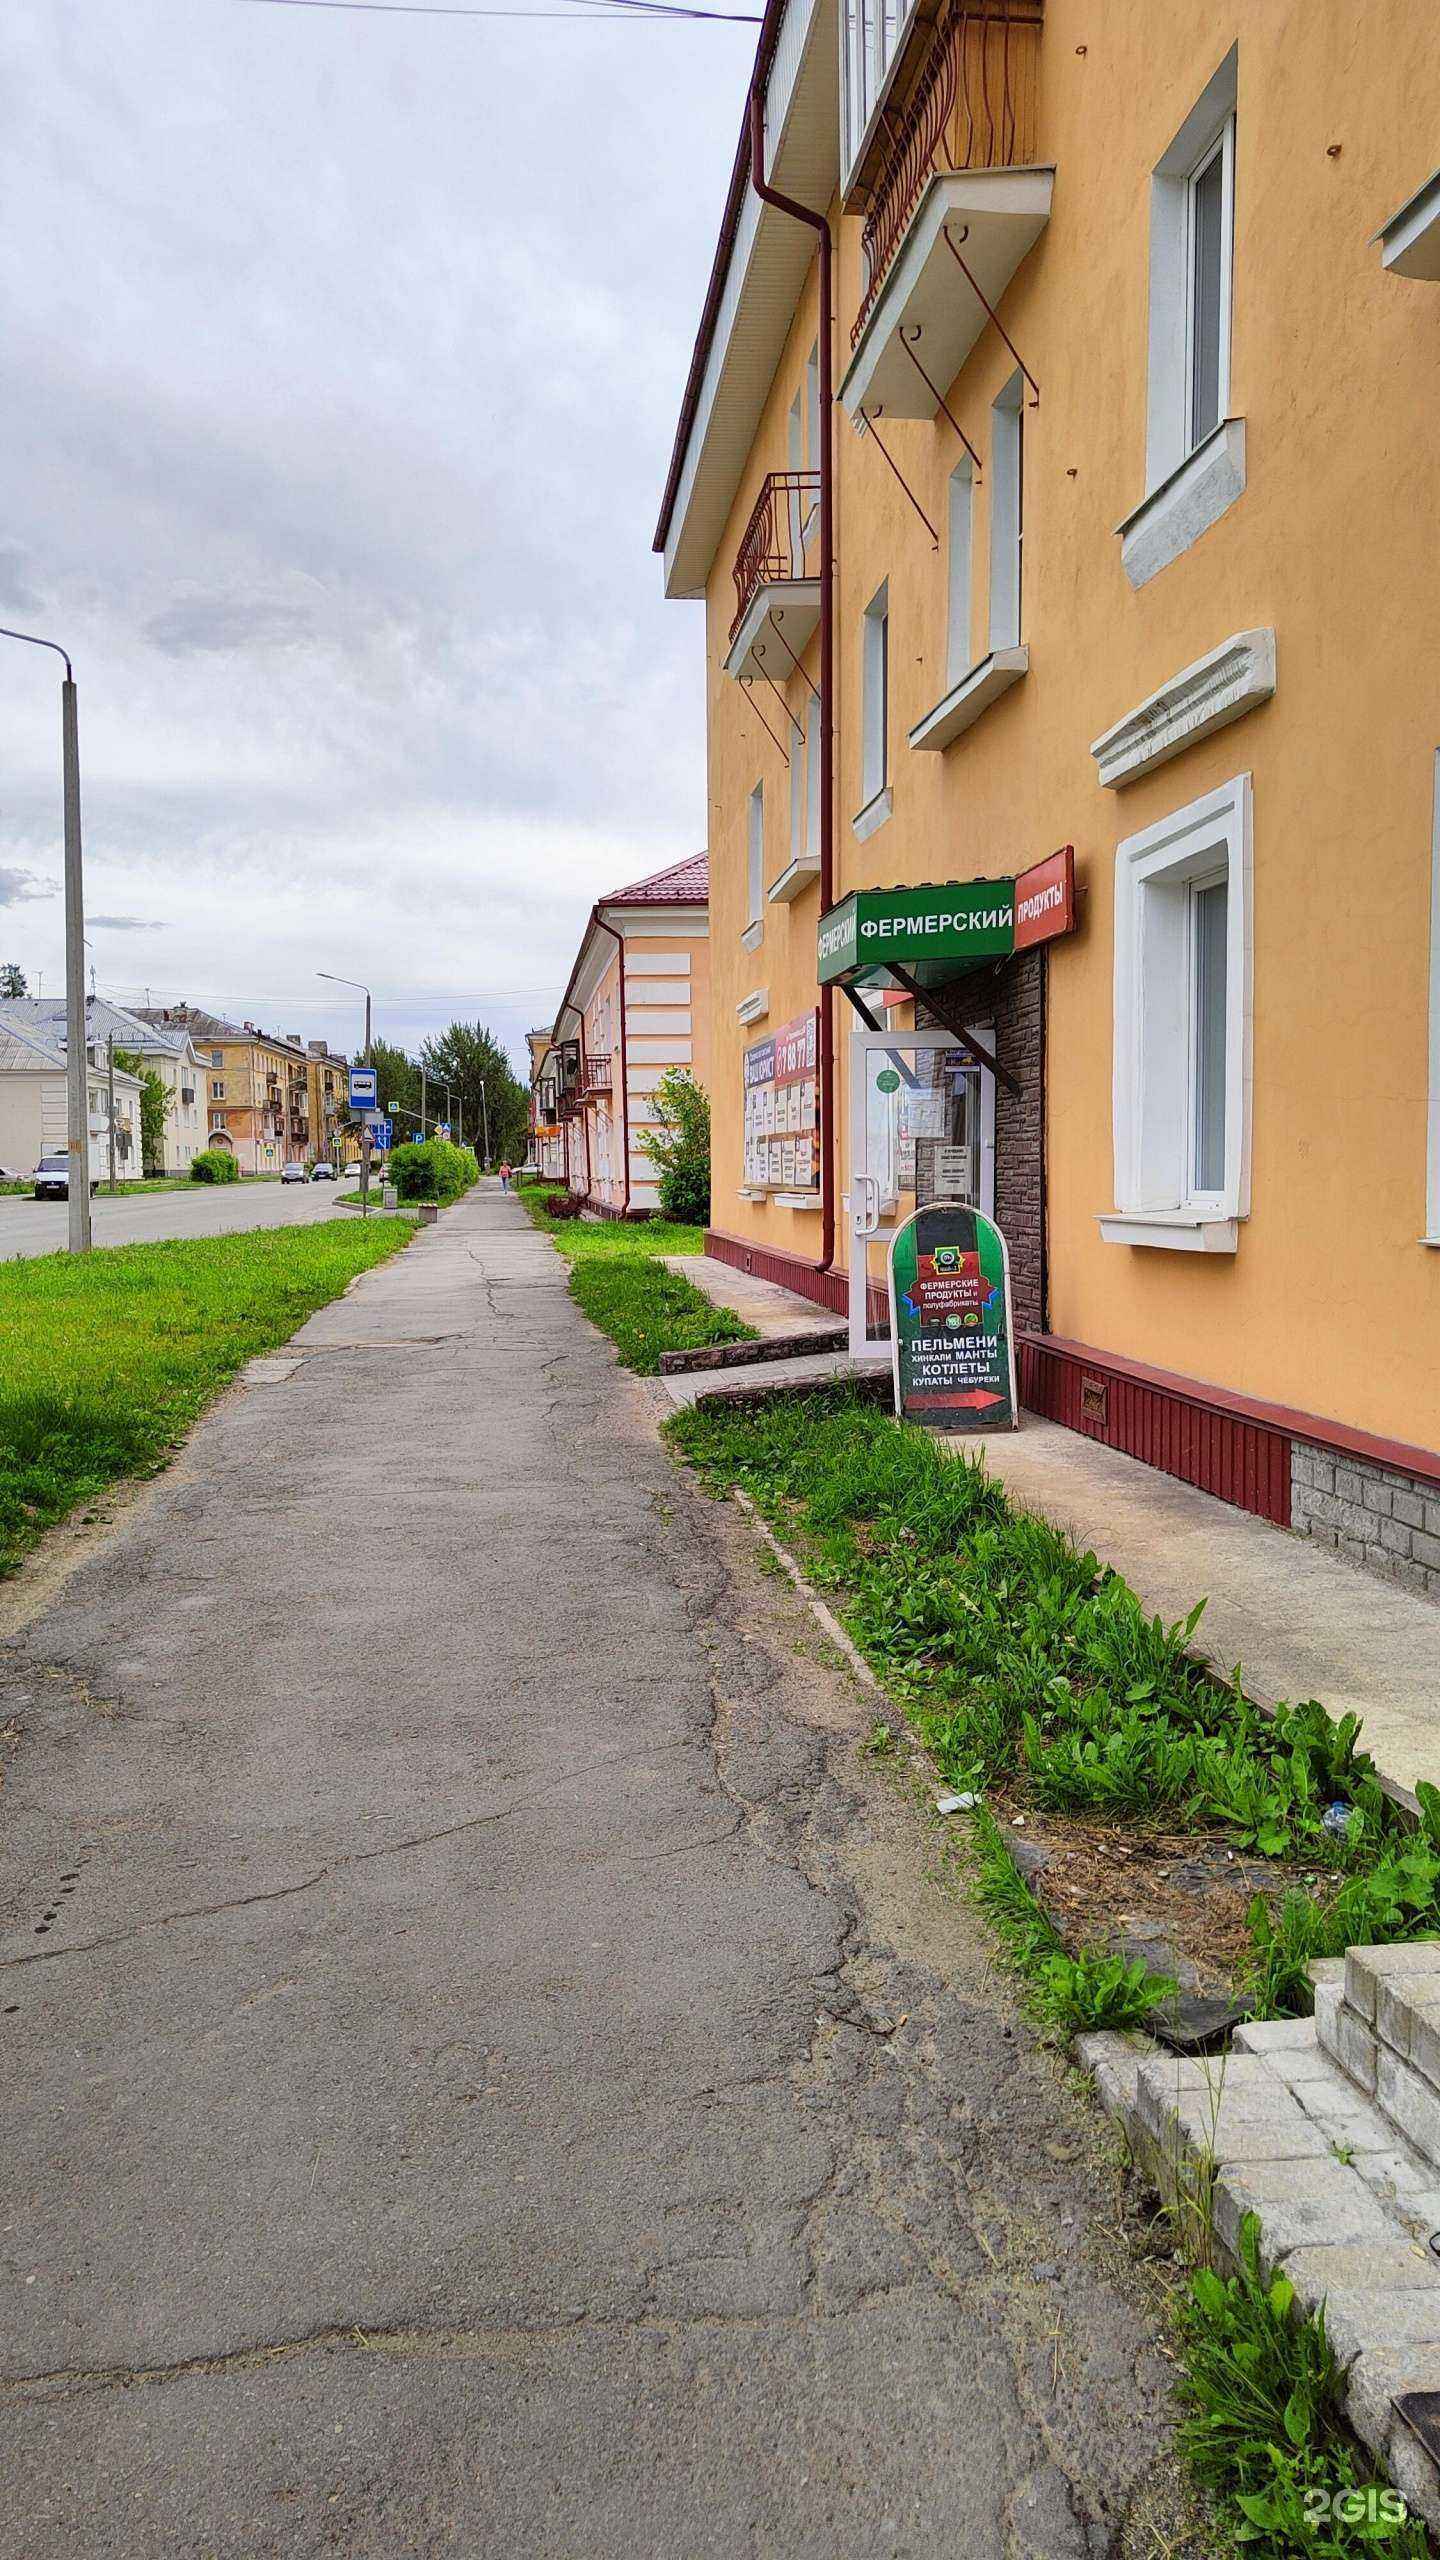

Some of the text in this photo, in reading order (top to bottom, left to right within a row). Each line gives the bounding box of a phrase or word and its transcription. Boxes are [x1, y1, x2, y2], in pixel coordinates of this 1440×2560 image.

[1017, 881, 1063, 924] ПРОДУКТЫ
[860, 904, 1013, 938] ФЕРМЕРСКИЙ
[817, 908, 857, 961] ФЕРМЕРСКИЙ
[920, 1279, 979, 1290] ФЕРМЕРСКИЕ
[924, 1289, 972, 1300] ПРОДУКТЫ
[922, 1299, 979, 1310] полуфабрикаты
[911, 1335, 997, 1352] ПЕЛЬМЕНИ
[911, 1349, 998, 1363] ХИНКАЛИ МАНТЫ
[922, 1362, 990, 1376] КОТЛЕТЫ
[912, 1375, 1000, 1387] КУПАТЫ ЧЕБУРЕКИ
